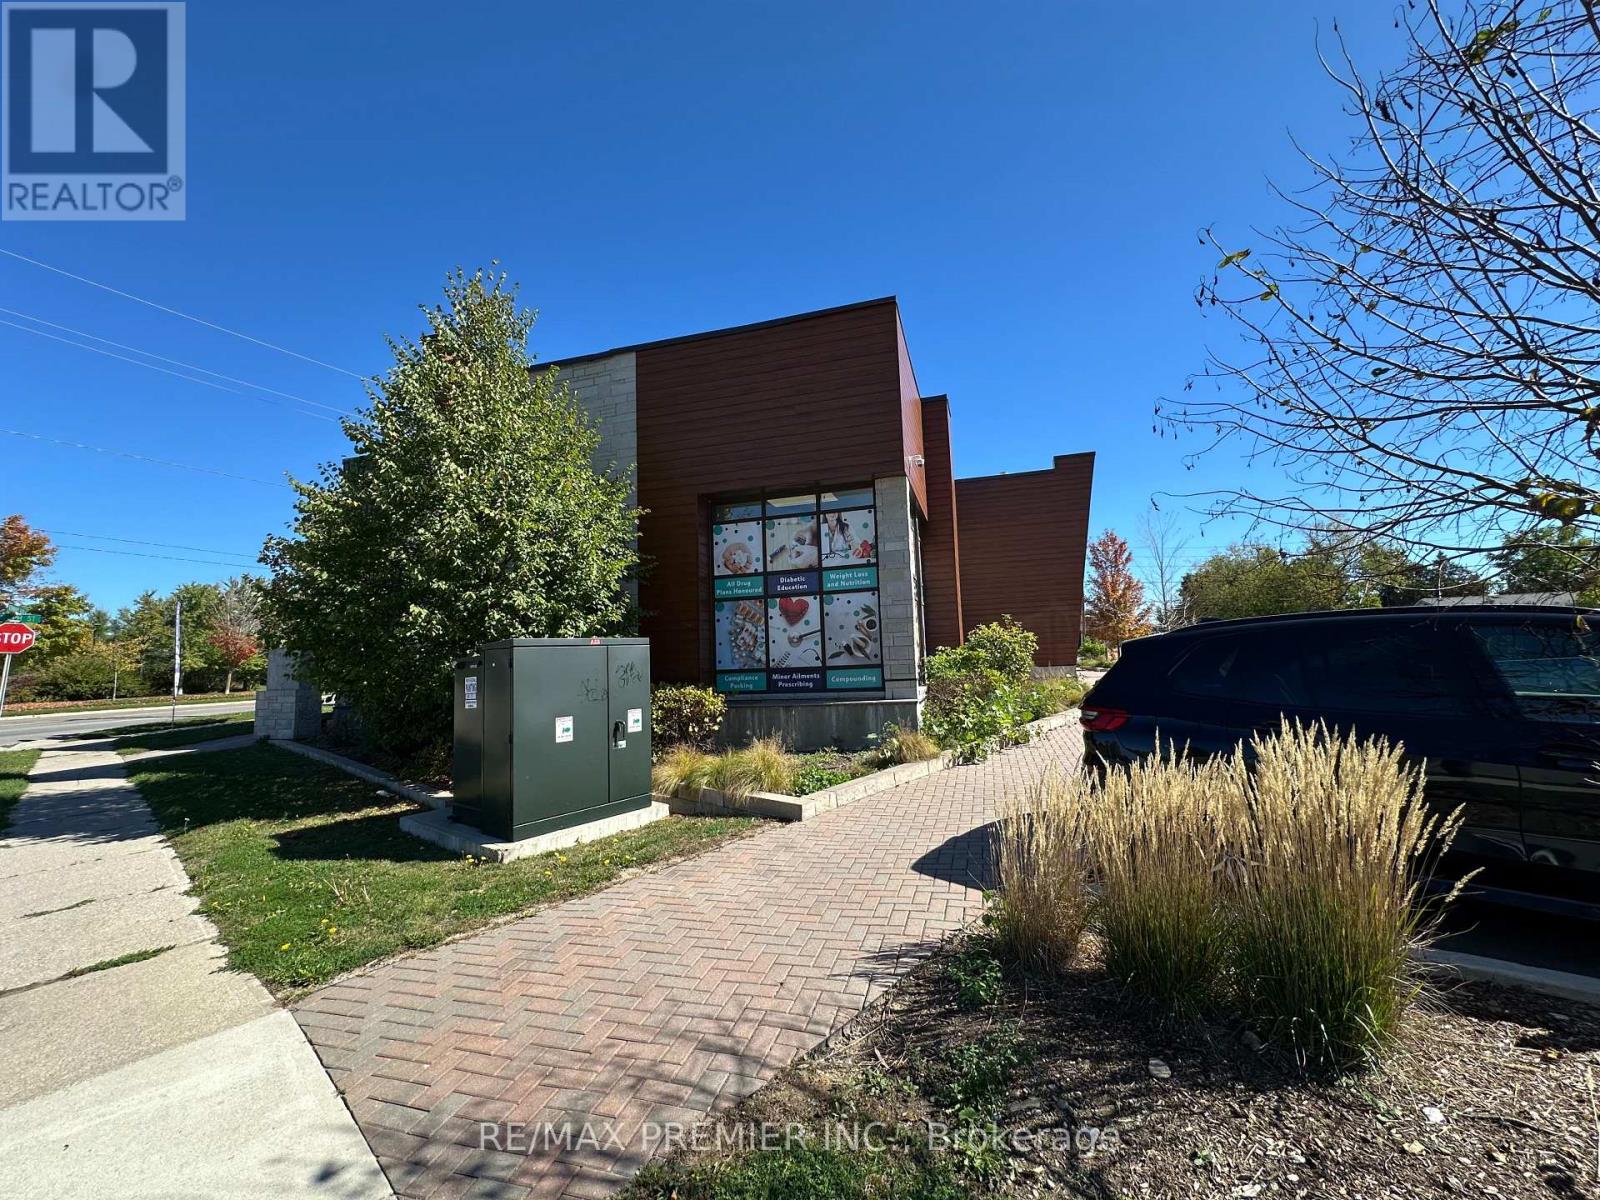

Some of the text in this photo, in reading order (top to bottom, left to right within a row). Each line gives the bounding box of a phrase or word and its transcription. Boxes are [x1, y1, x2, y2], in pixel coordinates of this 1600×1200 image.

[779, 576, 806, 584] Diabetic
[829, 572, 852, 581] Weight
[736, 580, 751, 588] Drug
[827, 579, 871, 588] and Nutrition
[716, 587, 762, 596] Plans Honoured
[724, 674, 759, 683] Compliance
[791, 672, 820, 680] Ailments
[831, 675, 877, 684] Compounding
[778, 680, 814, 689] Prescribing
